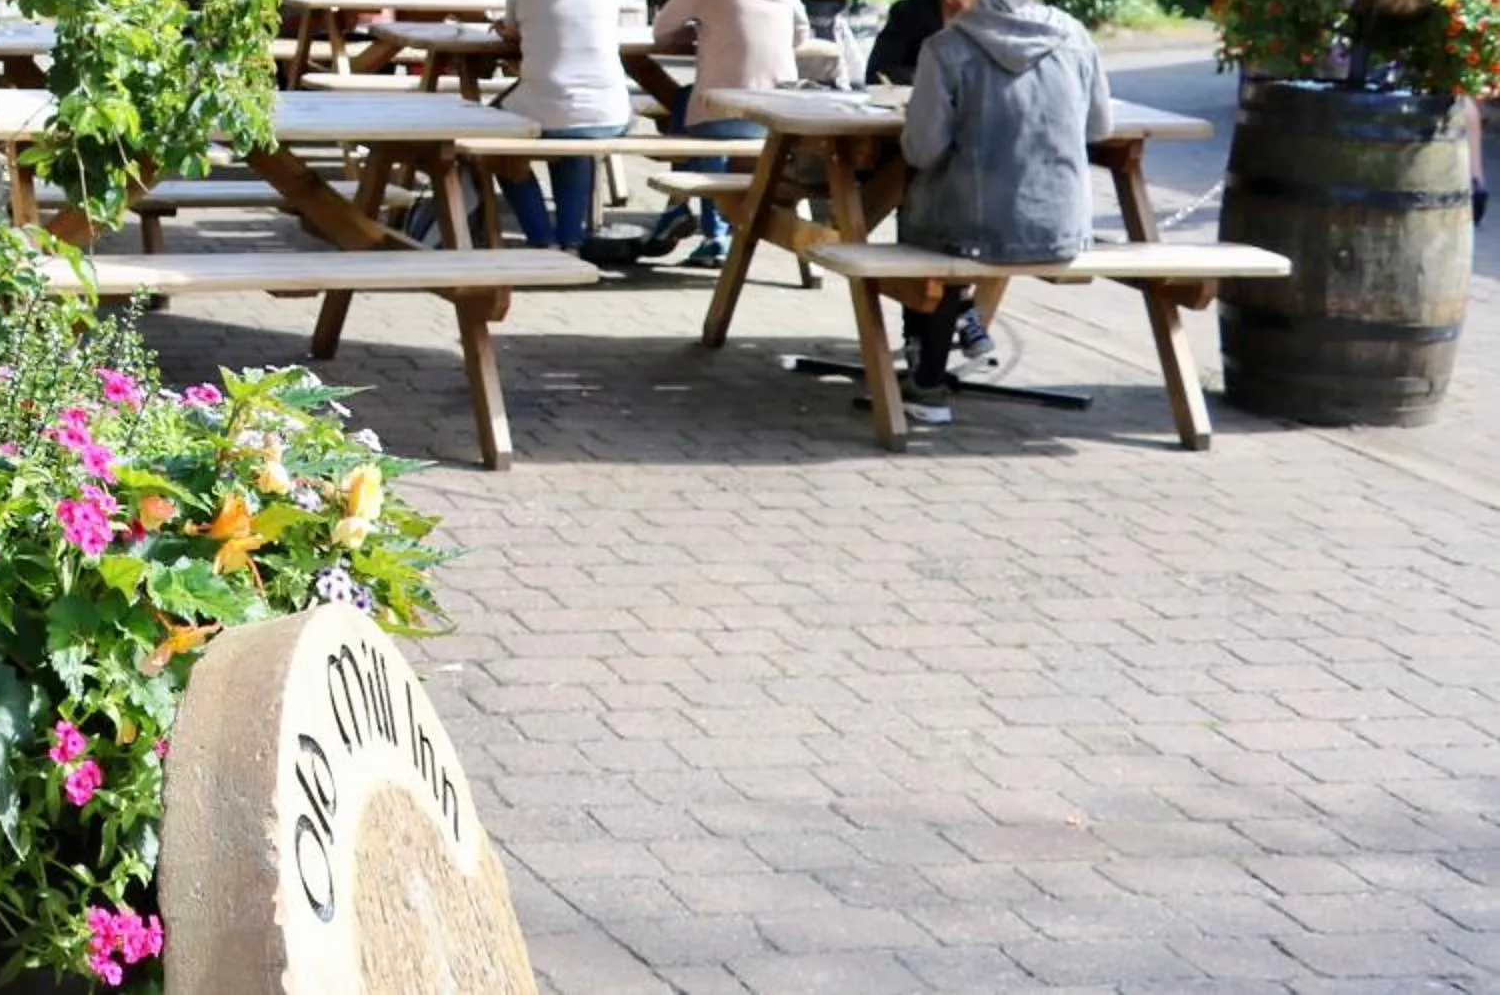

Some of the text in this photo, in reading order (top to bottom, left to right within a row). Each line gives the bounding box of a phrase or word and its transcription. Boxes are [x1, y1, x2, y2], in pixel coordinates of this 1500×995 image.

[294, 638, 461, 923] Old Mill Inn
